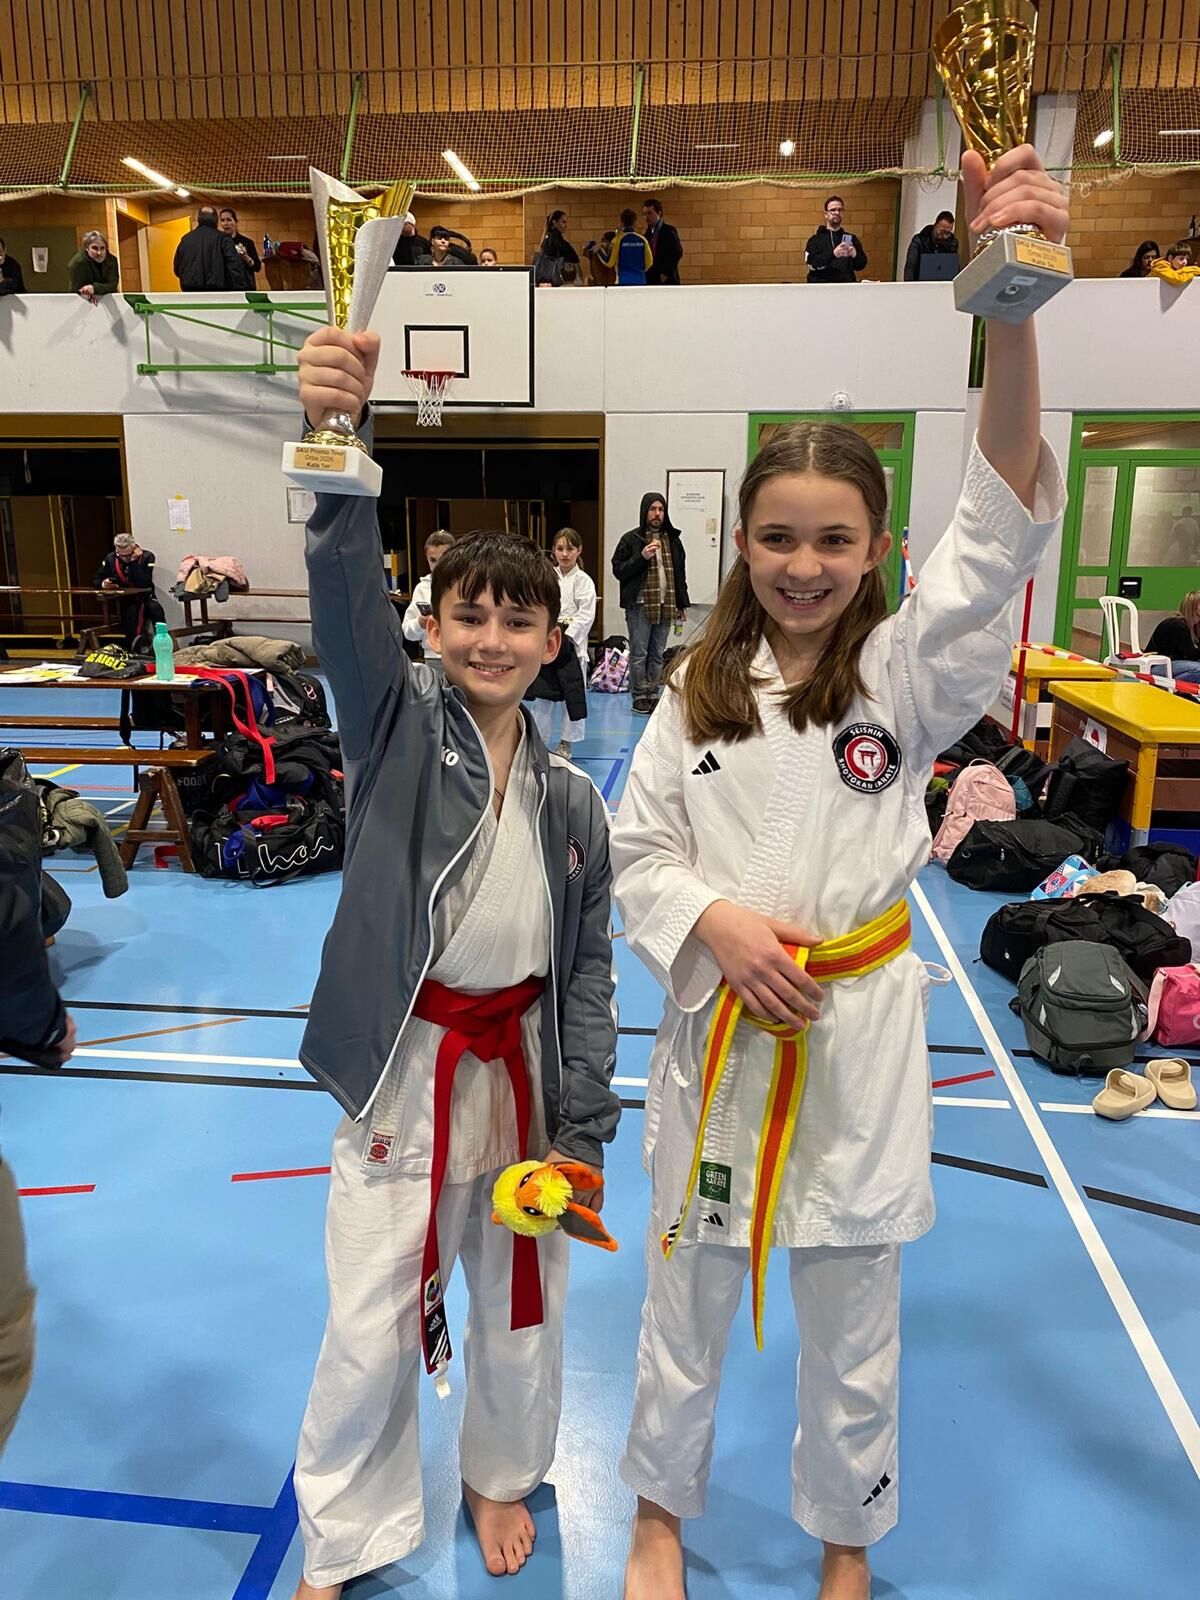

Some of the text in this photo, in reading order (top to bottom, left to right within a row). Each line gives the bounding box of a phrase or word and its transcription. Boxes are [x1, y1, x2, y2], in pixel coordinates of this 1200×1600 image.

[95, 653, 127, 671] AIGLE
[850, 727, 884, 738] SEISHIN
[839, 758, 873, 789] SHOTOKAN
[705, 1170, 727, 1182] GREEN
